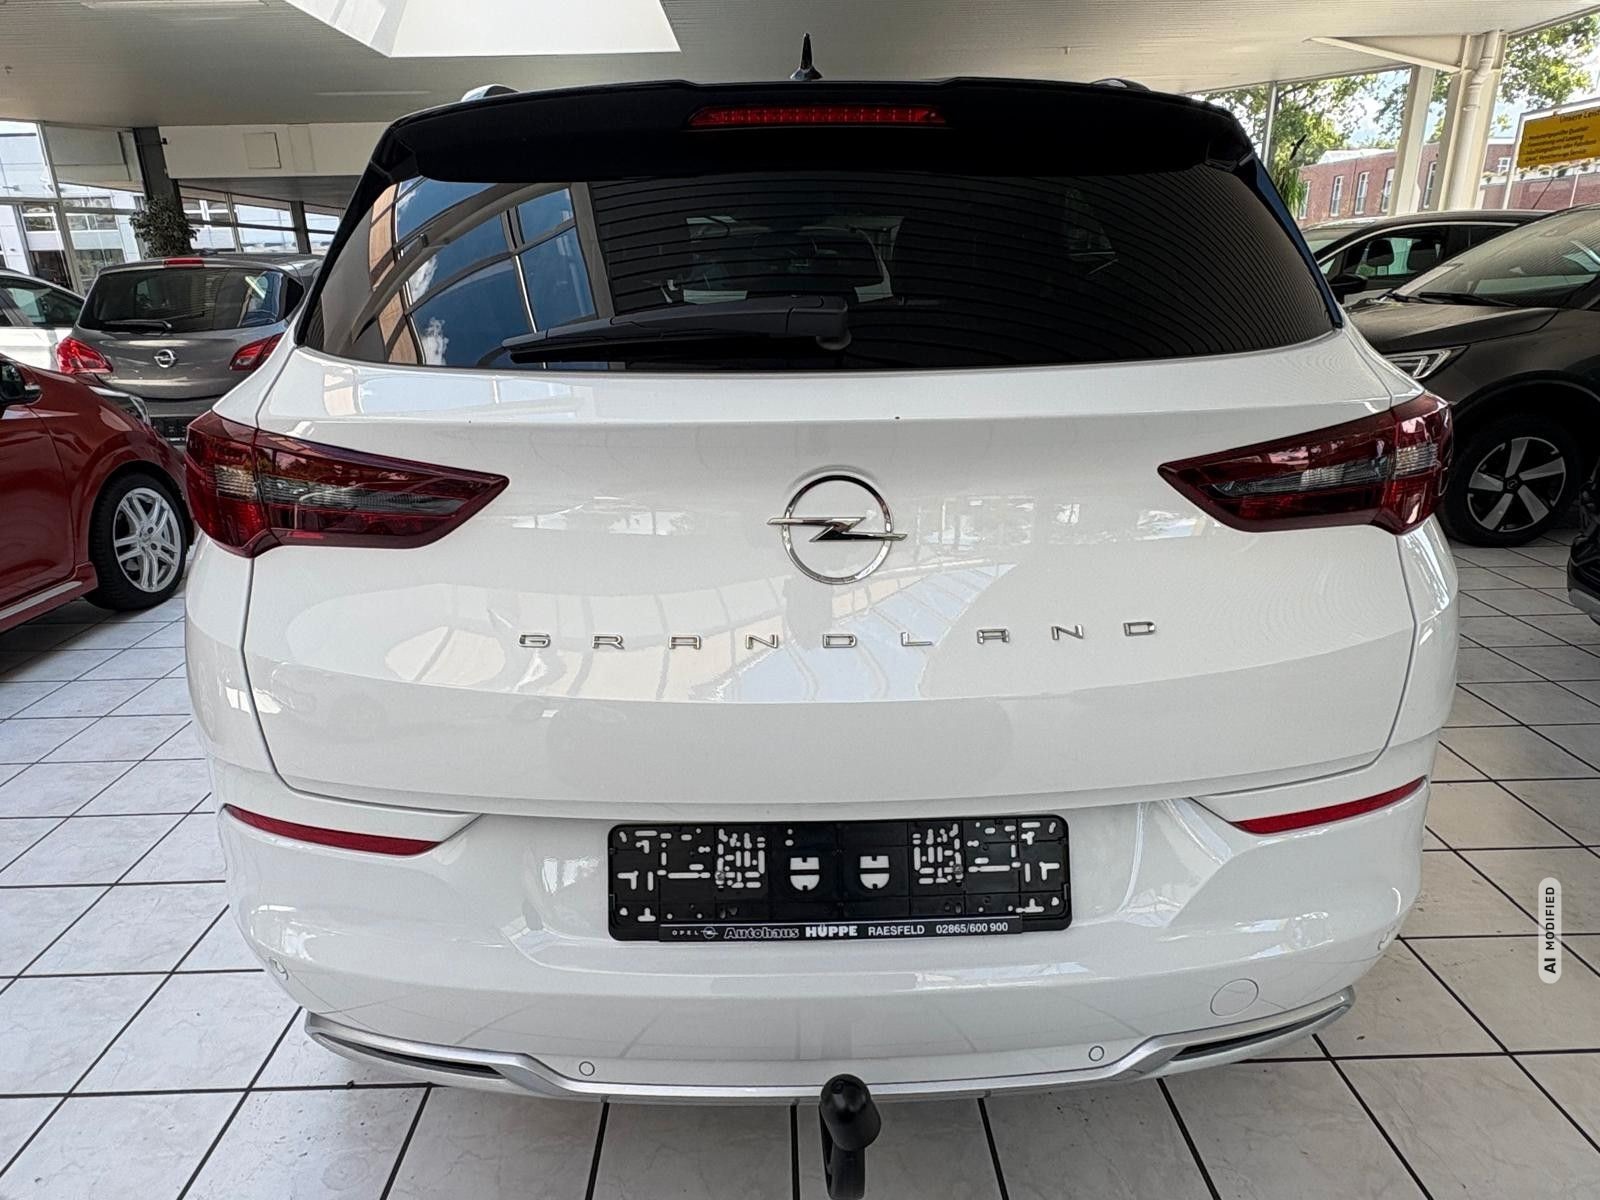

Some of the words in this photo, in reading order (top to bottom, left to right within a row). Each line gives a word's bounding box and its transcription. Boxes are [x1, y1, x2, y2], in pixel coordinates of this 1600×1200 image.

[518, 620, 1157, 651] GRANDLAND
[671, 929, 699, 937] OPEL
[724, 926, 799, 939] Autohaus
[805, 924, 858, 938] HÜPPE
[868, 924, 925, 936] RAESFELD
[936, 922, 988, 934] 02865/600
[990, 921, 1009, 933] 900
